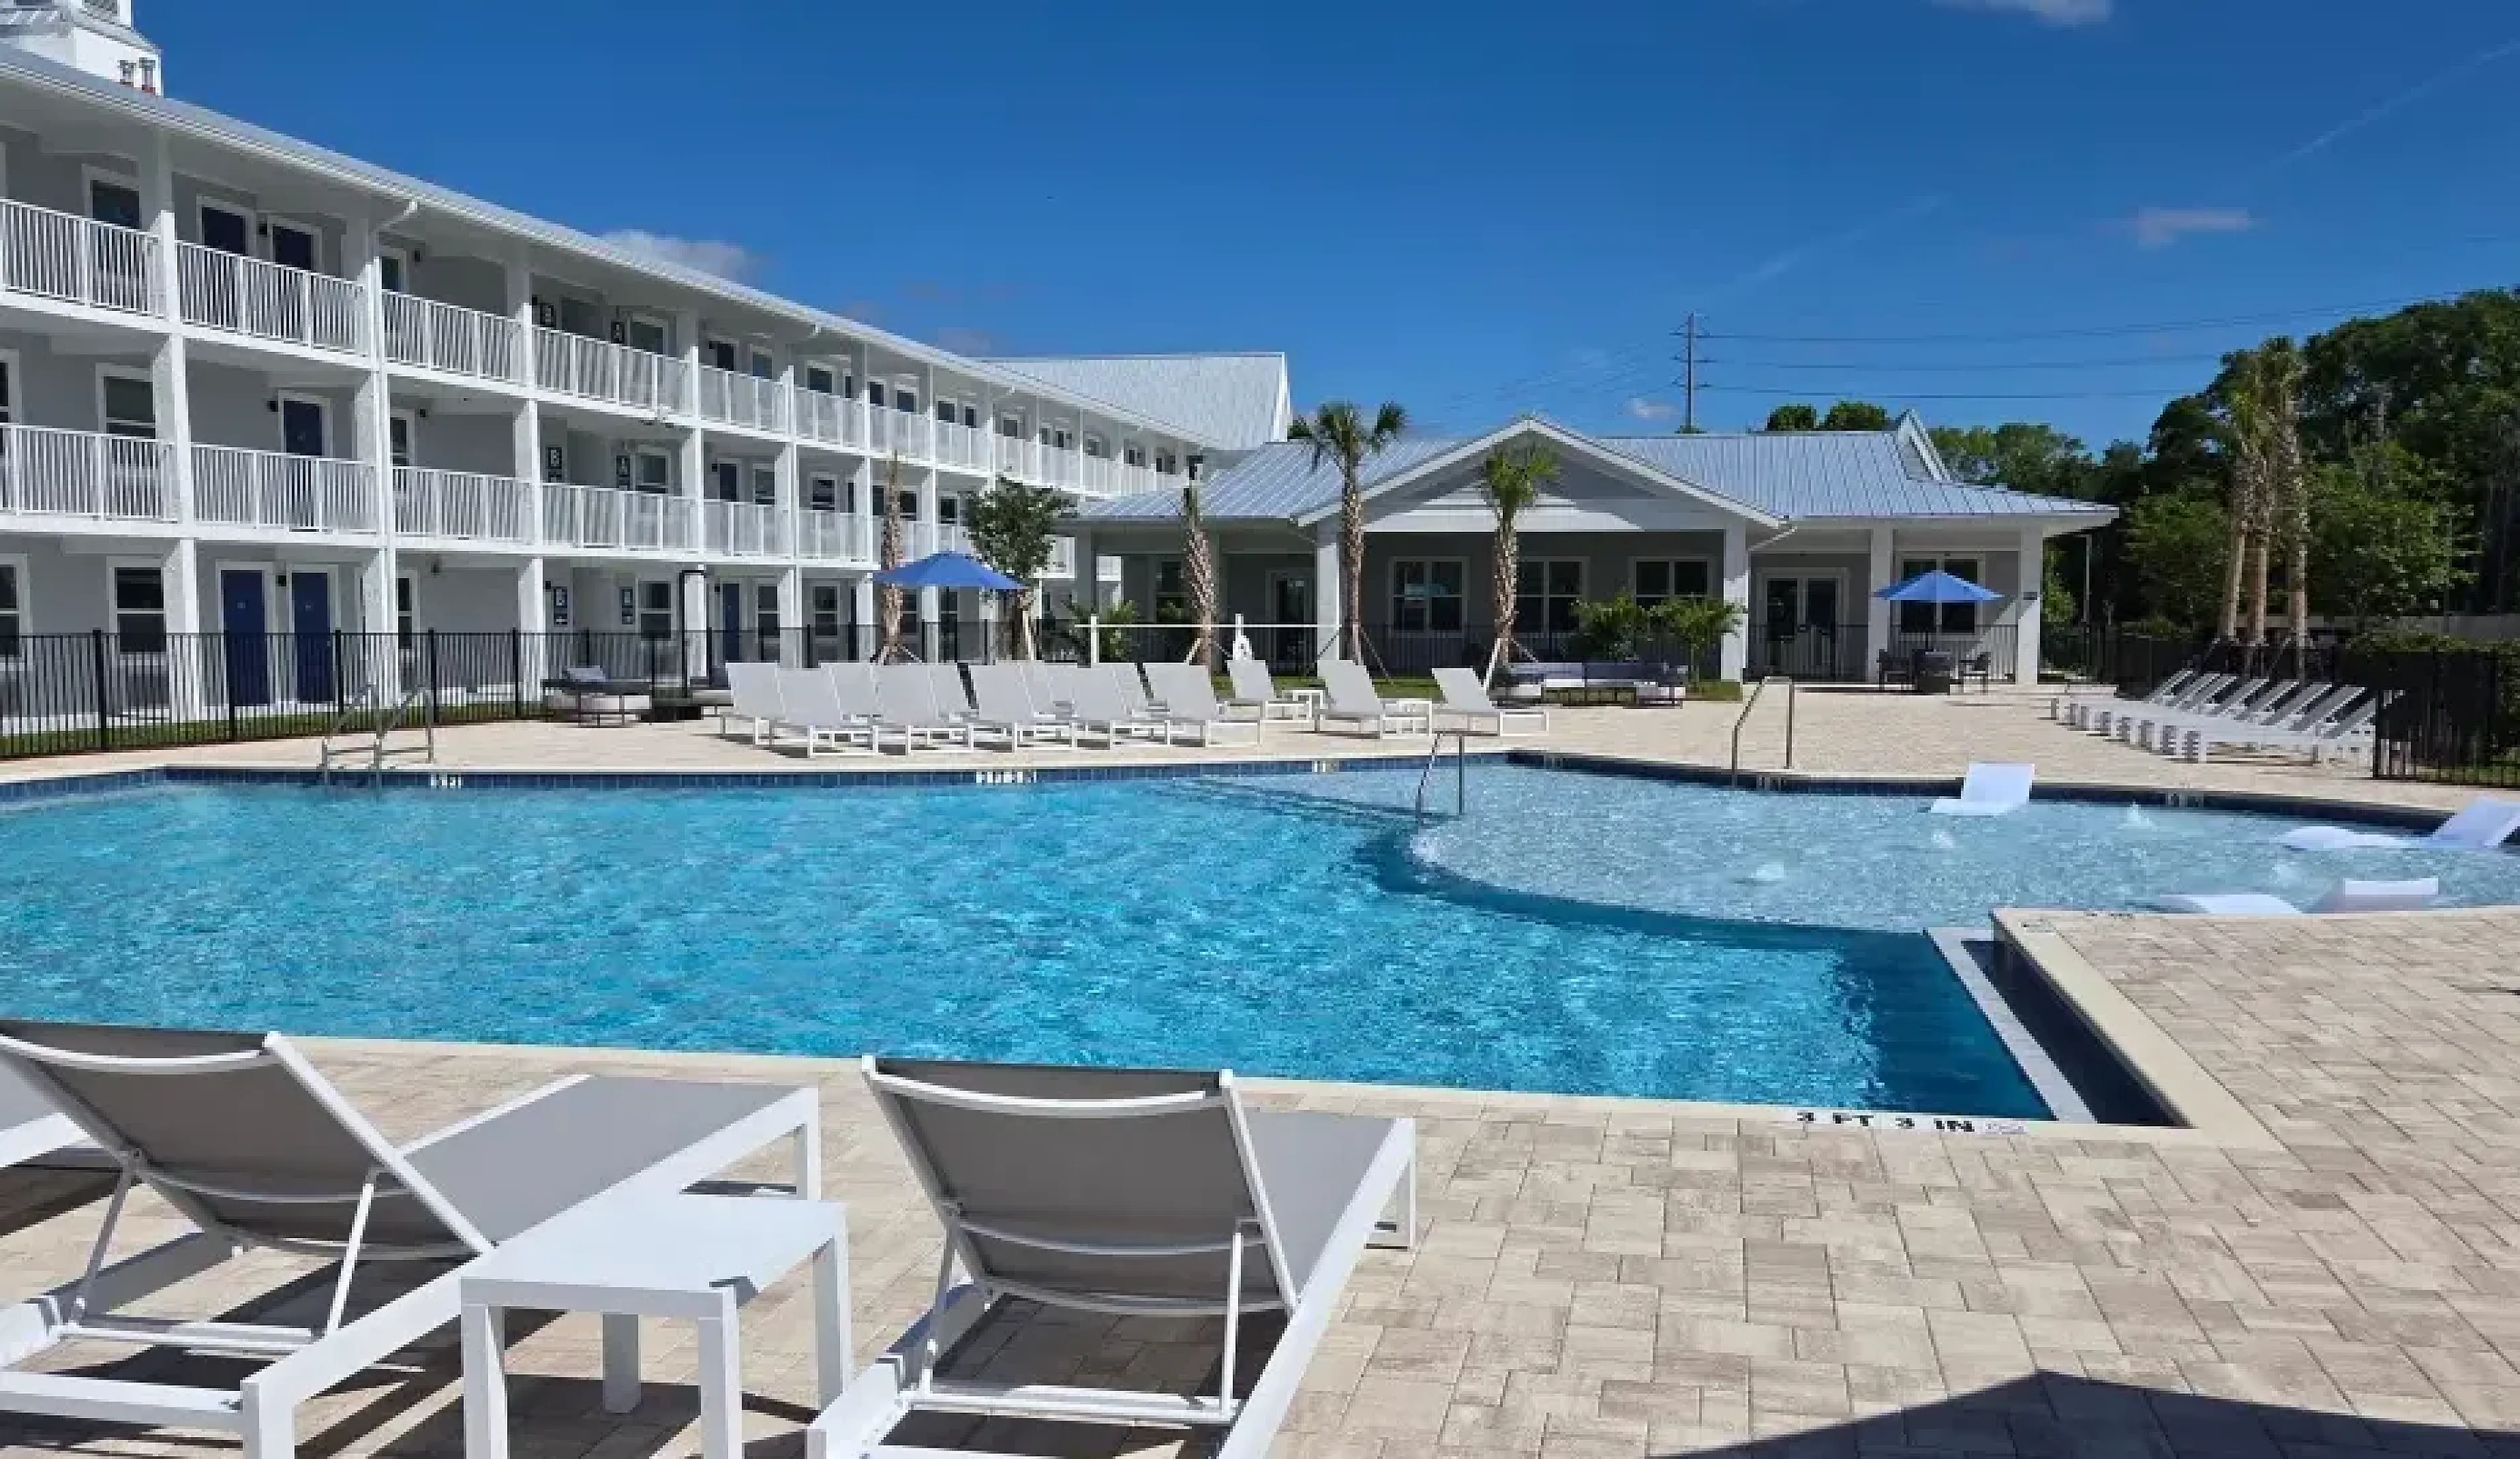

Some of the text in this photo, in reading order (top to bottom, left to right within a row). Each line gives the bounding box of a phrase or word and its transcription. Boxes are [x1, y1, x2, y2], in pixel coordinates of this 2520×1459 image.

[550, 449, 560, 468] B
[556, 589, 566, 606] B
[1797, 1111, 1975, 1132] 3 FT 3 IN
